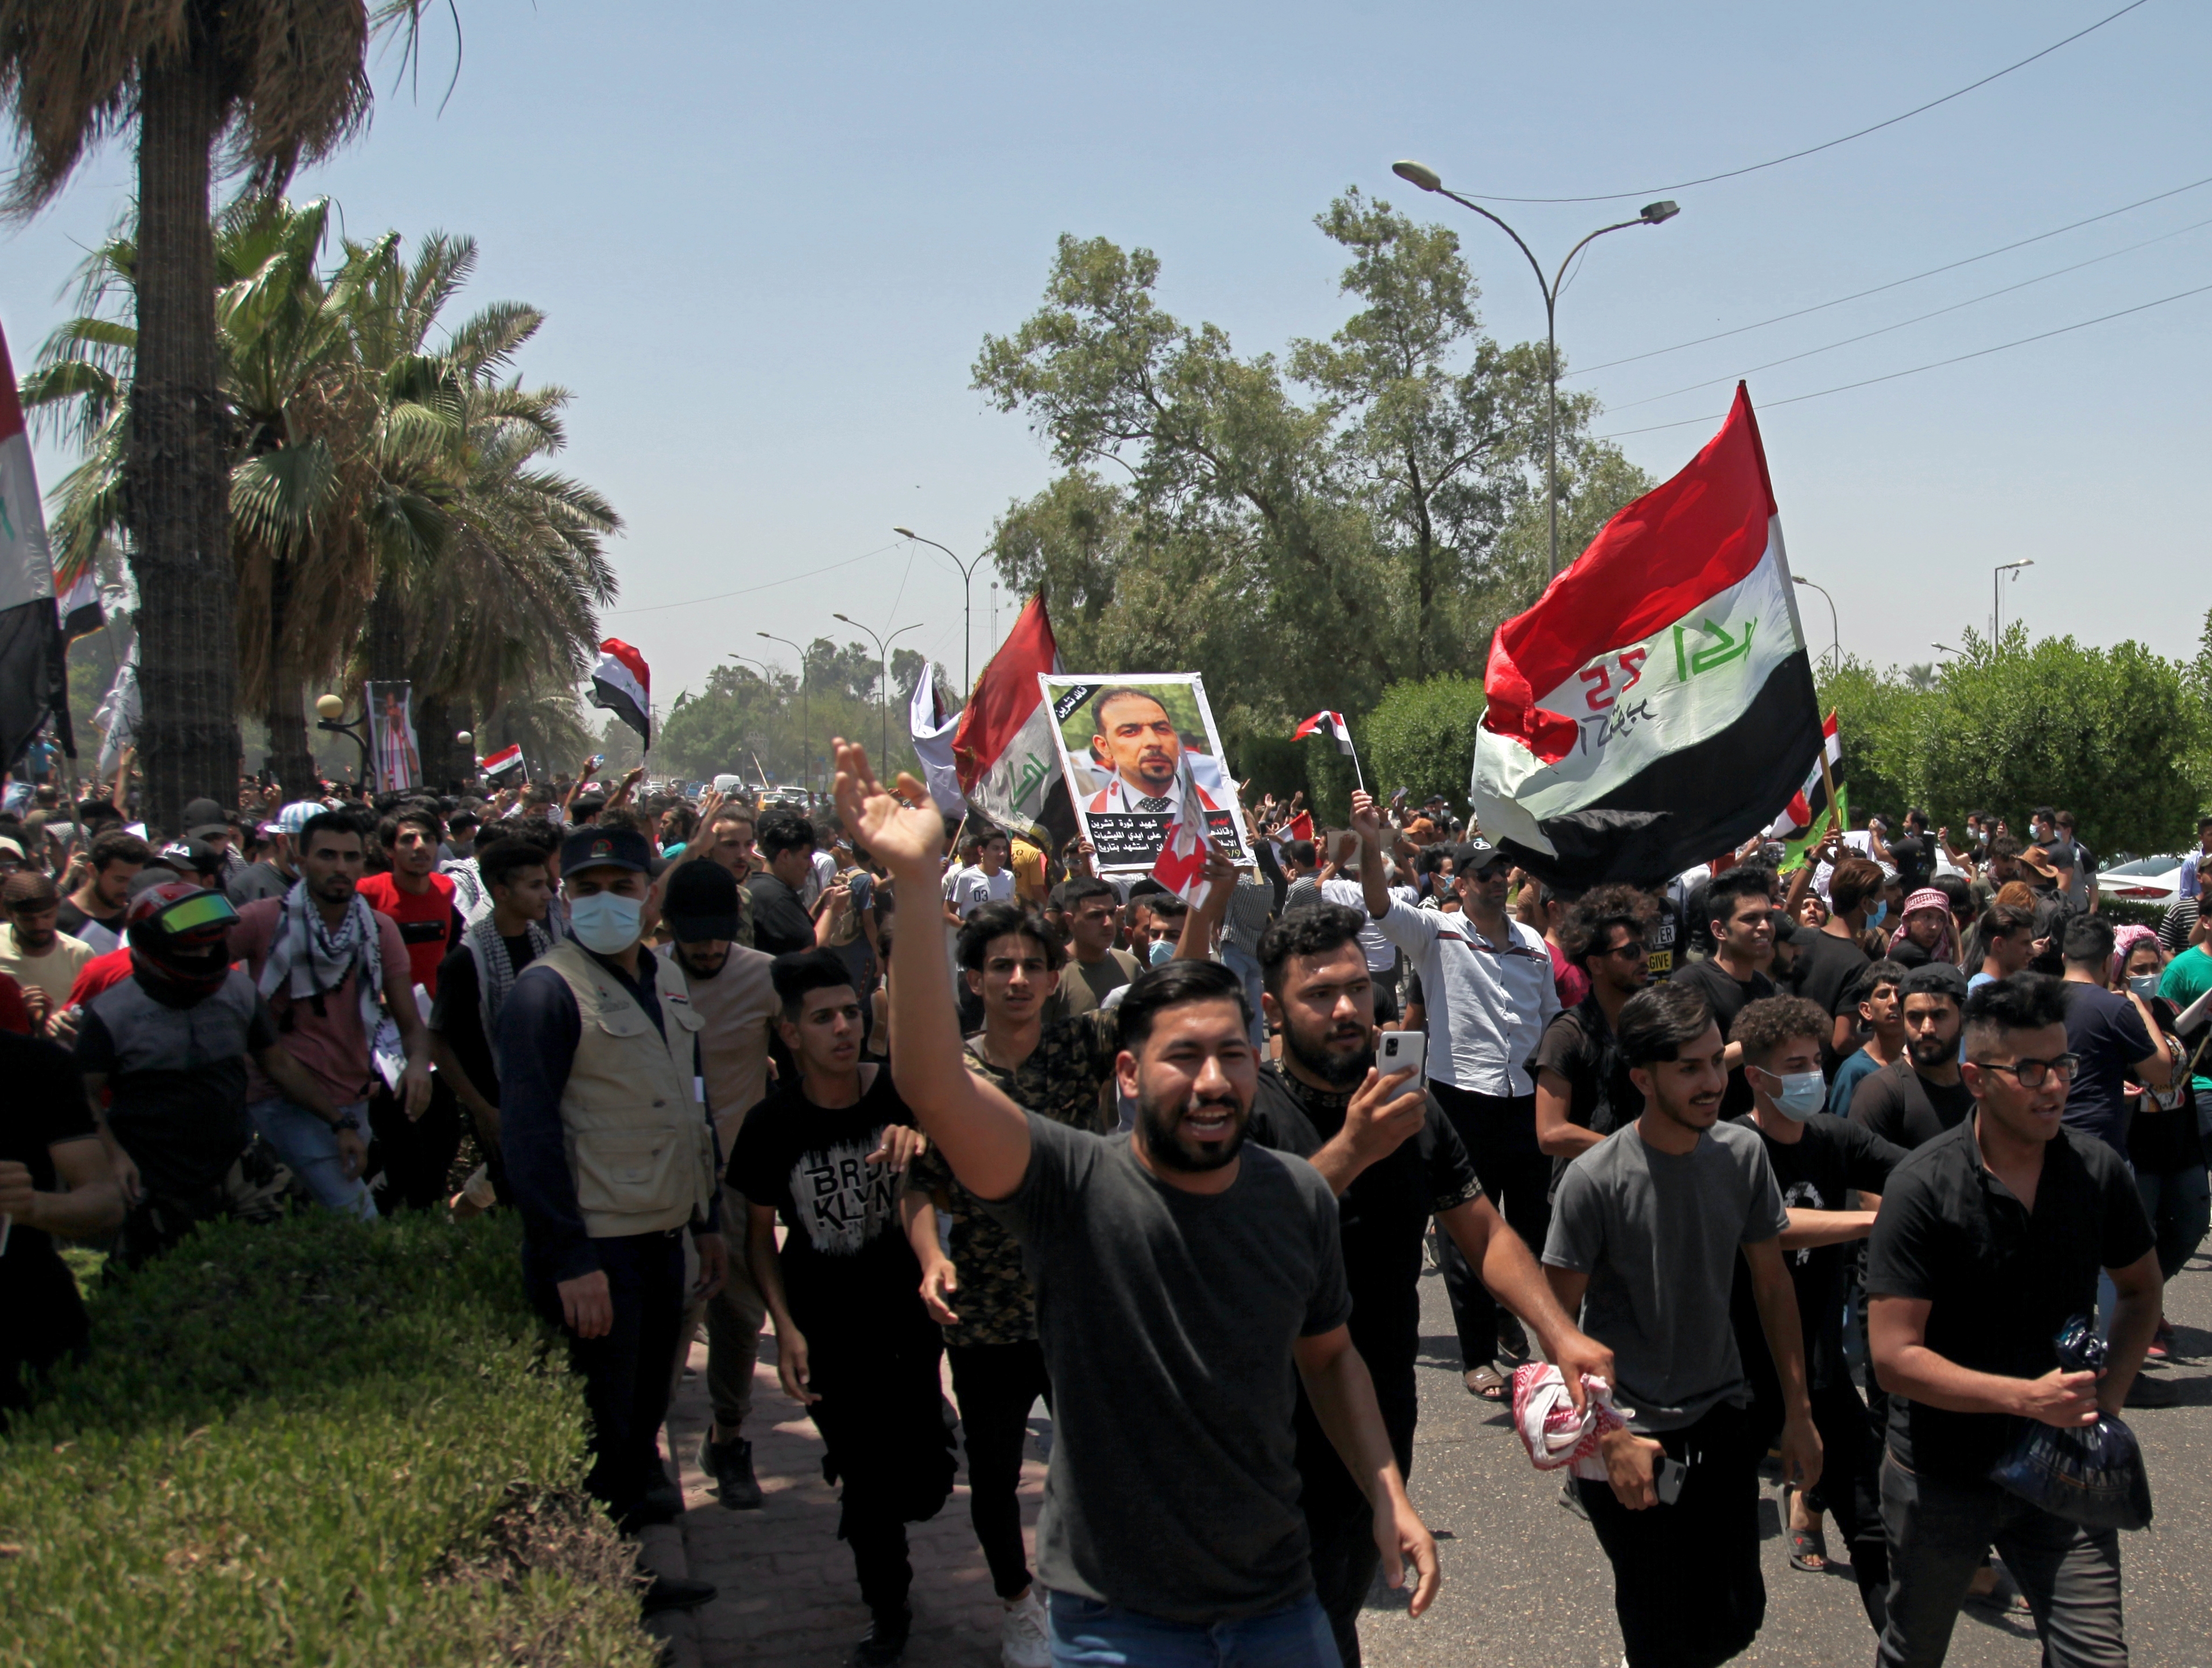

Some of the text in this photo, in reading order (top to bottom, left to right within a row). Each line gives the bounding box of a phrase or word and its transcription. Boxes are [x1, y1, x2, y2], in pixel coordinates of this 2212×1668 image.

[1055, 685, 1088, 719] قائد تشرين
[1091, 819, 1114, 829] تشرين
[1118, 819, 1134, 828] ثورة
[1139, 819, 1157, 829] شهيد
[1128, 832, 1144, 841] ايدي
[1147, 832, 1161, 840] على
[974, 890, 988, 902] 03
[1649, 953, 1669, 969] GIVE
